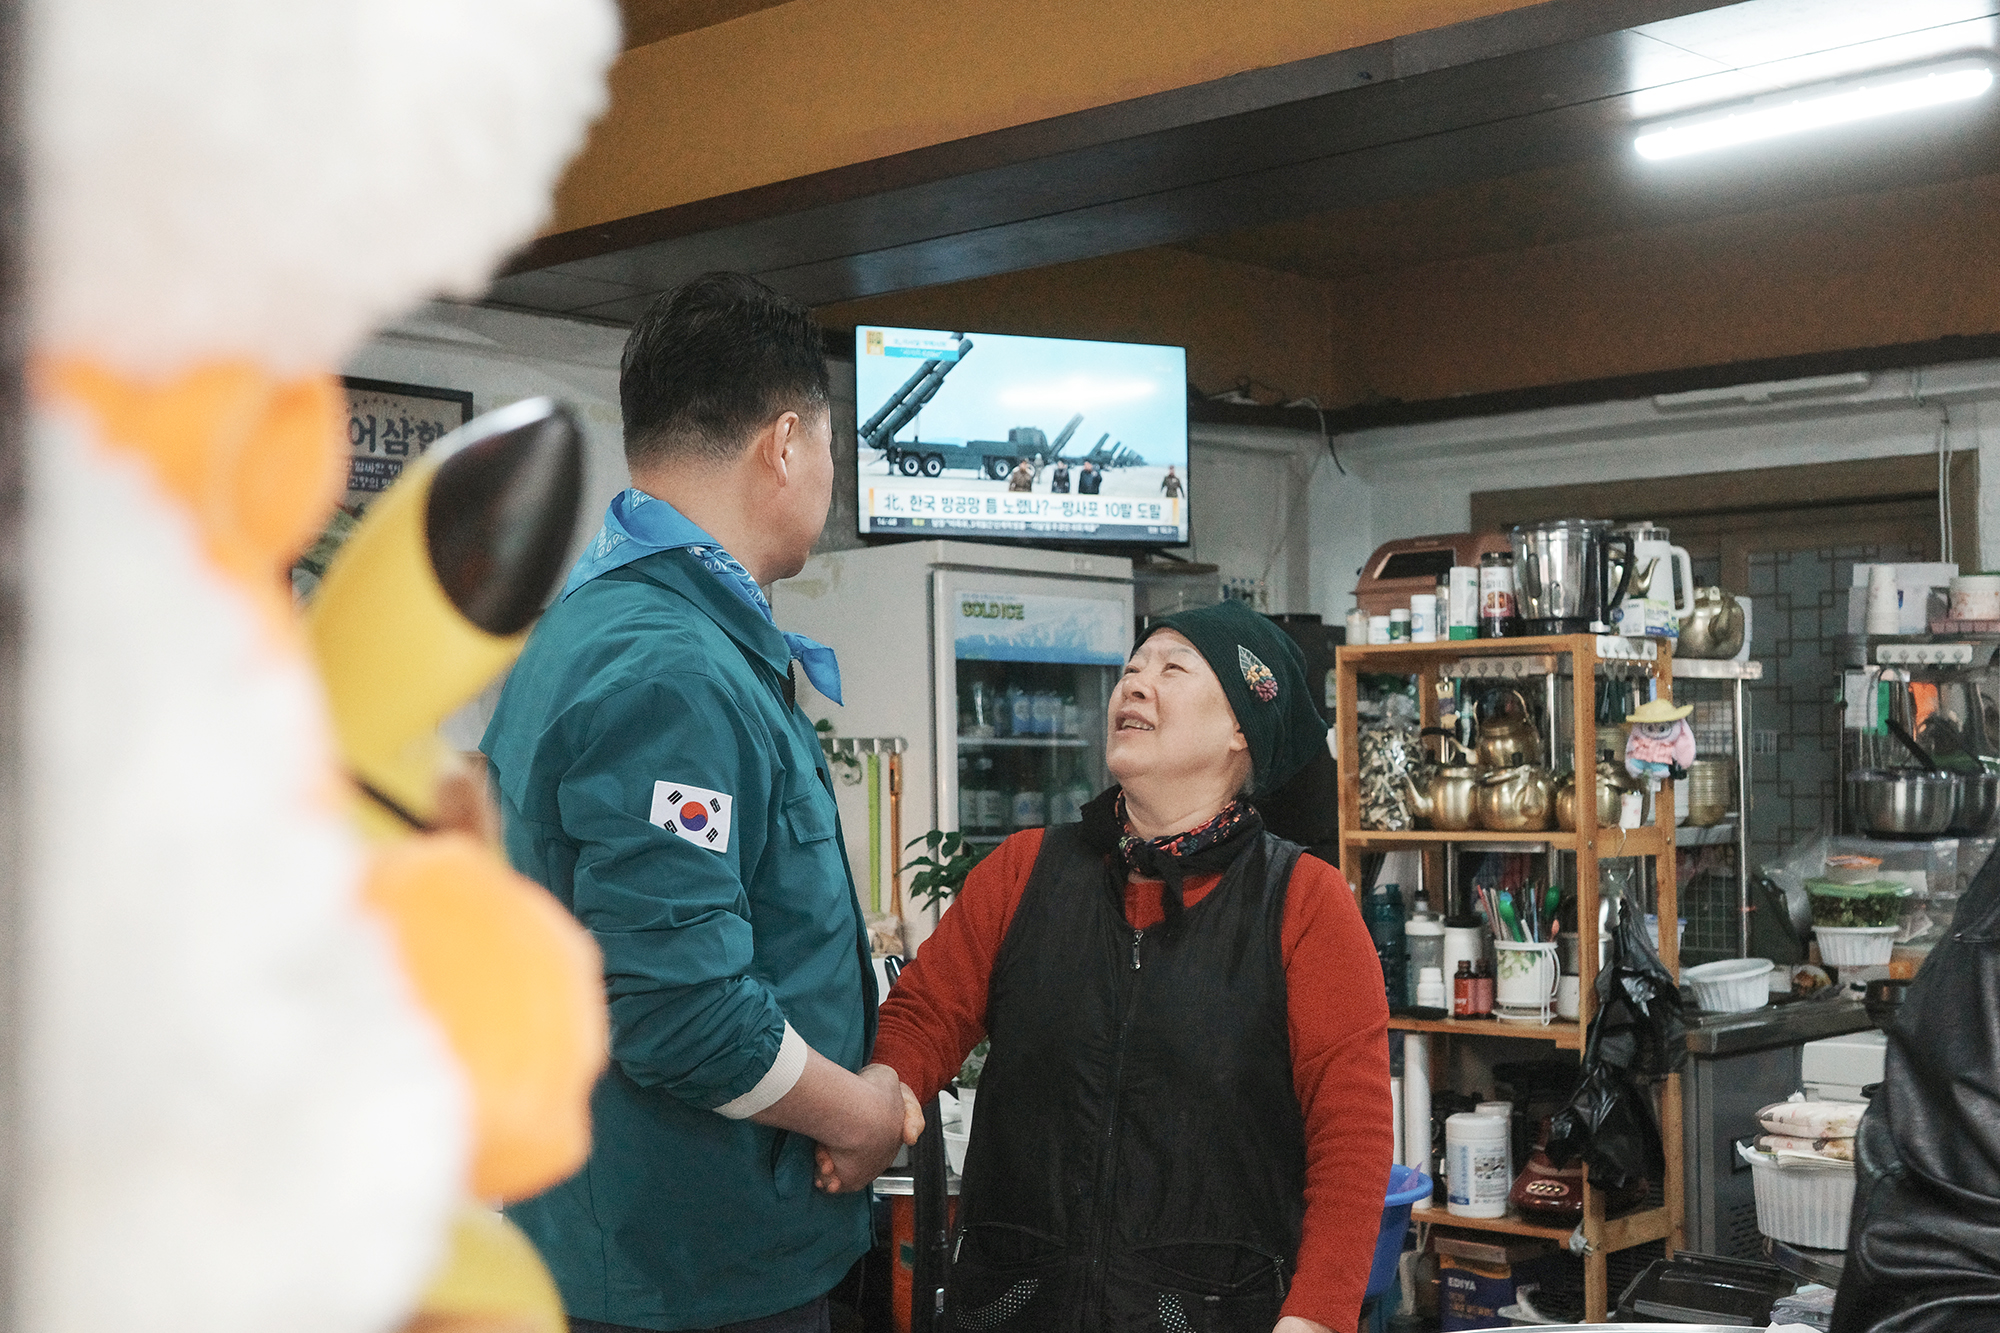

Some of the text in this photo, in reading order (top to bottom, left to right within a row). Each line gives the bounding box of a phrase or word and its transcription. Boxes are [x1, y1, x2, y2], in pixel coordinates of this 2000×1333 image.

[910, 494, 935, 512] 한국
[941, 495, 980, 514] 방공망
[1105, 503, 1132, 519] 10발
[1137, 503, 1161, 520] 도발
[962, 600, 1025, 621] GOLD ICE
[1447, 1276, 1477, 1292] EDIYA
